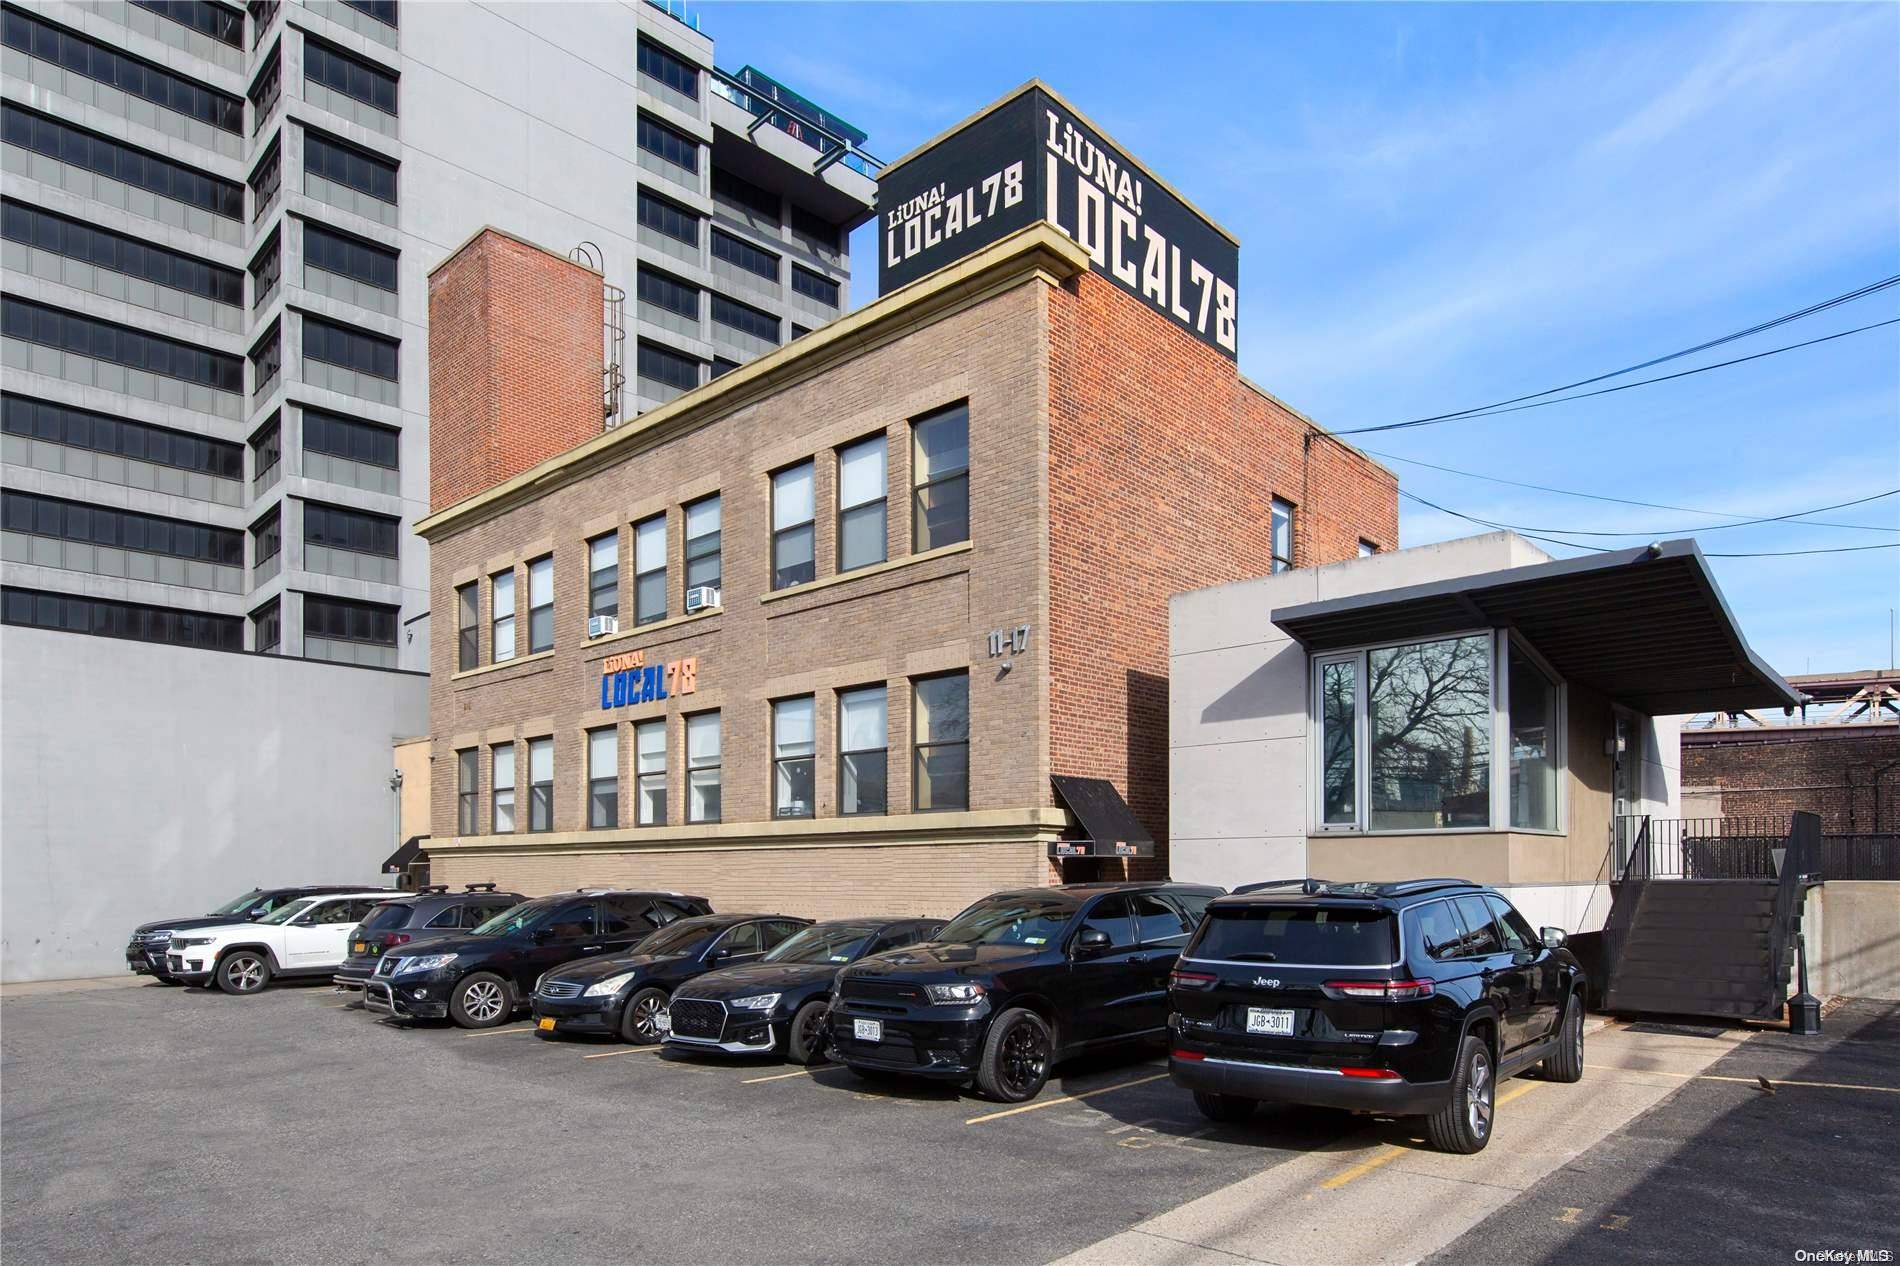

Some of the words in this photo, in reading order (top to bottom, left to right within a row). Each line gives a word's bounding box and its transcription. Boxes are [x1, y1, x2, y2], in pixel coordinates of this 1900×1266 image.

[1046, 109, 1143, 216] LiUNA!
[888, 182, 946, 230] LiUNA!
[989, 624, 1031, 655] 11-17
[1253, 976, 1281, 988] Jeep
